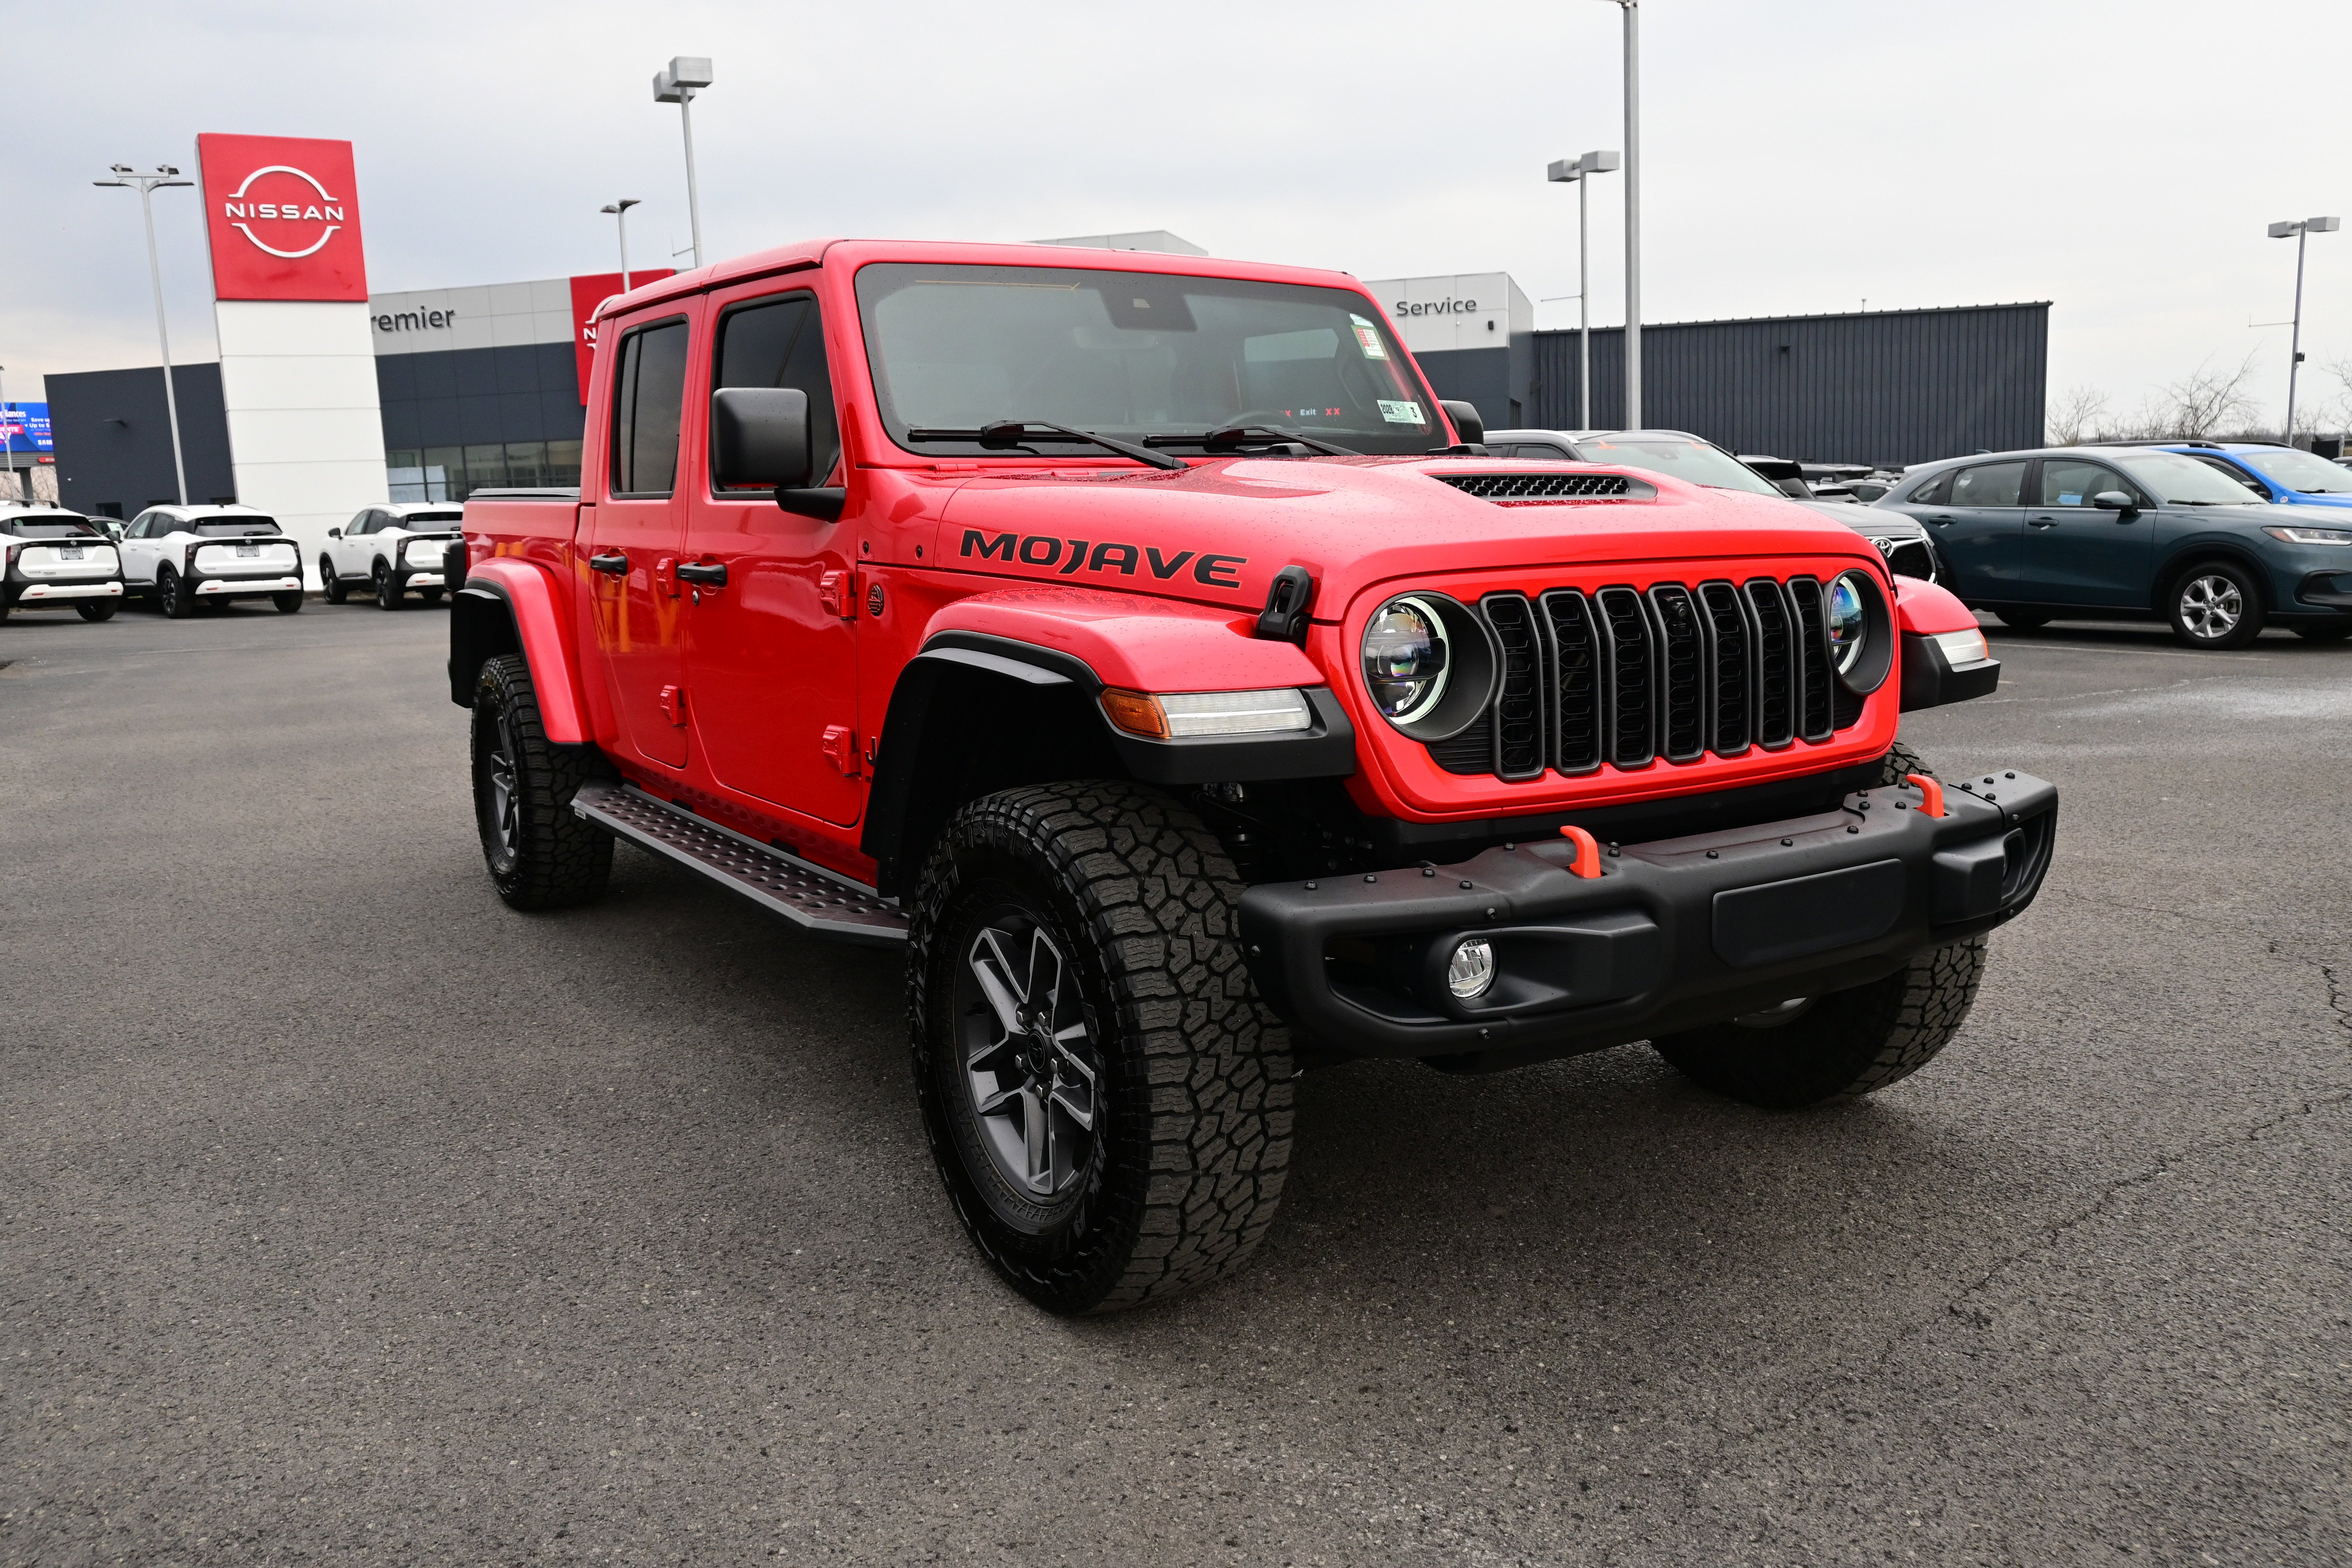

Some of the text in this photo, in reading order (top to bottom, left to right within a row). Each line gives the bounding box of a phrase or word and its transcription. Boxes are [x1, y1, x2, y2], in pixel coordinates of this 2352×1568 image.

[225, 203, 344, 220] NISSAN
[1396, 297, 1477, 316] Service
[1300, 408, 1316, 416] Exit
[1410, 407, 1417, 418] 3
[959, 529, 1248, 588] MOJAVE
